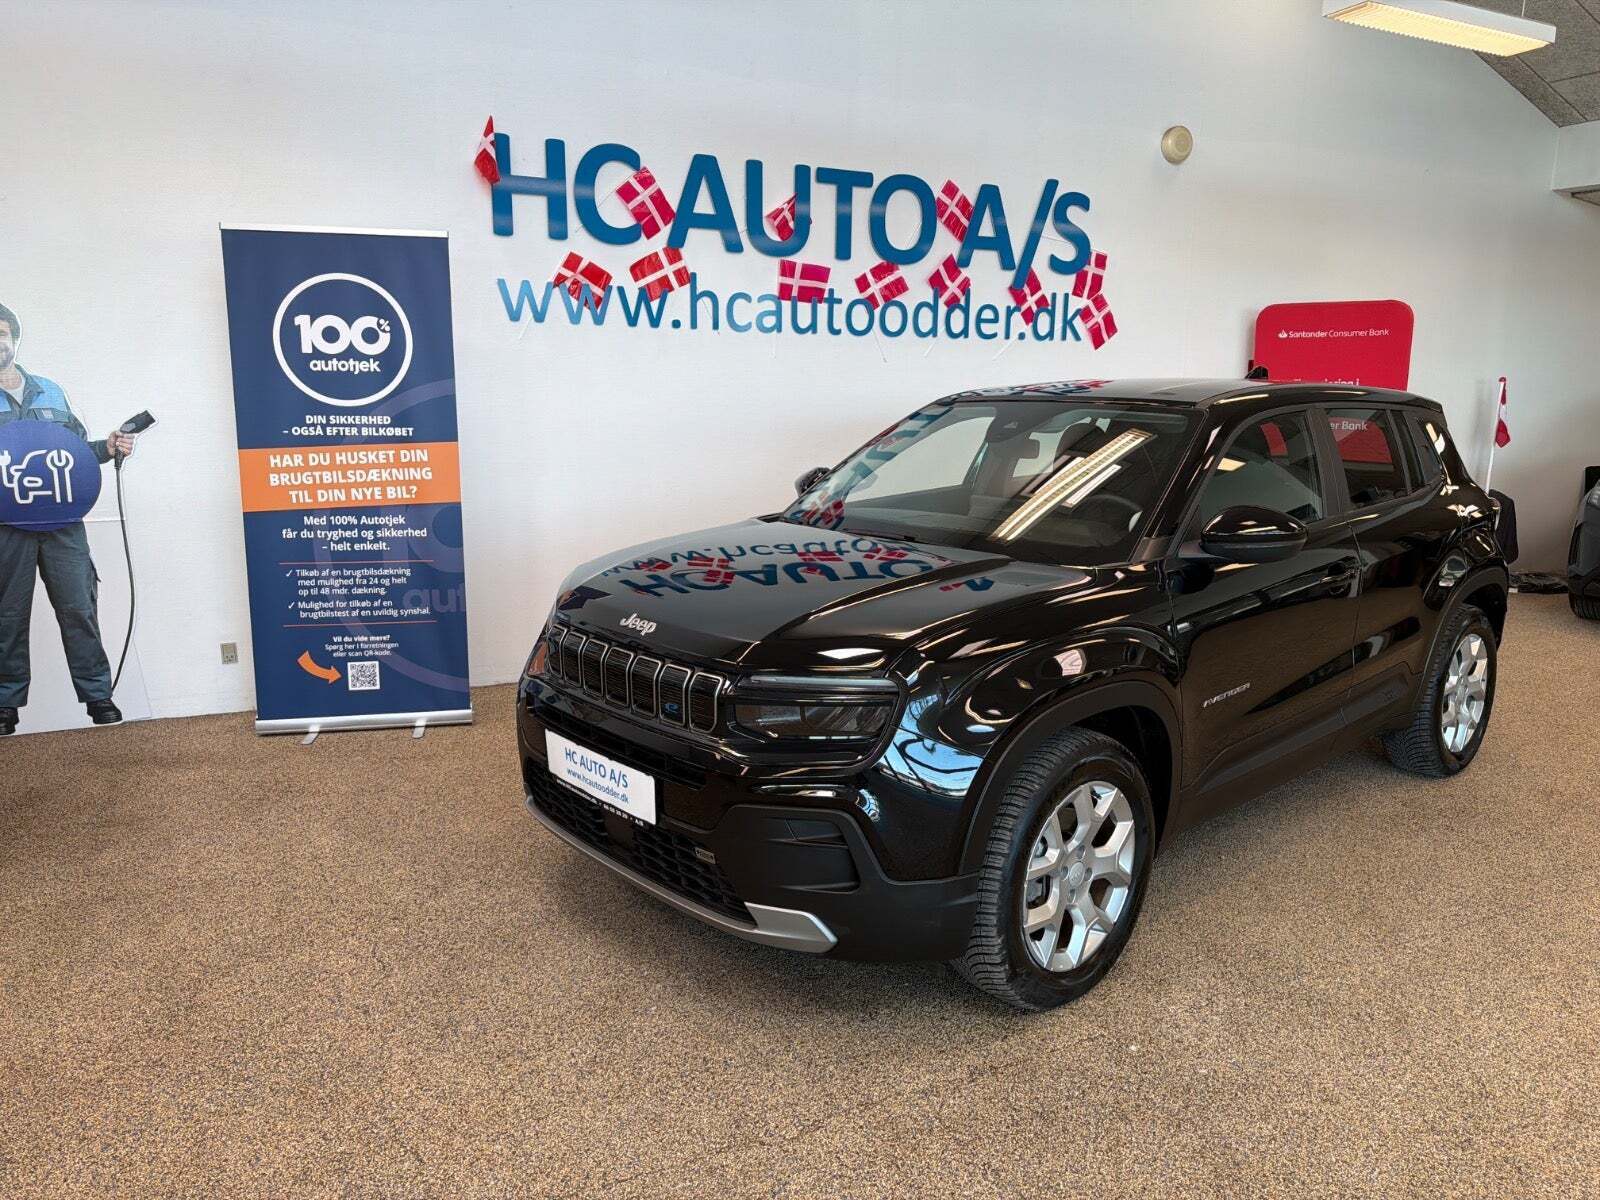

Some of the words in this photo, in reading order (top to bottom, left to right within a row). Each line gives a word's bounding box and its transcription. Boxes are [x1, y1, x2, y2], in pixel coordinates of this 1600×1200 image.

[491, 132, 642, 246] HC
[667, 153, 937, 265] AUTO
[957, 179, 1091, 290] A/S
[497, 272, 1082, 341] www.hcautoodder.dk
[1289, 330, 1328, 338] Santander
[1329, 329, 1369, 337] Consumer
[1370, 328, 1390, 336] Bank
[310, 358, 381, 374] autotjek
[306, 415, 326, 425] DIN
[329, 415, 391, 425] SIKKERHED
[292, 424, 323, 436] OGSÅ
[327, 427, 358, 436] EFTER
[362, 426, 414, 437] BILKØBET
[270, 454, 304, 468] HAR
[309, 453, 330, 466] DU
[336, 450, 395, 465] HUSKET
[400, 449, 428, 463] DIN
[270, 468, 432, 486] BRUGTBILSDÆKNING
[289, 490, 313, 504] TIL
[317, 489, 346, 503] DIN
[351, 488, 382, 501] NYE
[387, 486, 417, 499] BIL?
[304, 516, 326, 526] Med
[330, 516, 357, 525] 100%
[360, 516, 405, 528] Autotjek
[282, 529, 298, 539] får
[301, 529, 314, 538] du
[317, 529, 358, 541] tryghed
[361, 530, 374, 540] og
[376, 528, 427, 537] sikkerhed
[330, 541, 350, 551] helt
[354, 542, 390, 551] enkelt.
[296, 569, 320, 577] Tilkøb
[343, 568, 411, 577] brugtbilsdækning
[318, 578, 354, 587] mulighed
[380, 578, 390, 586] og
[351, 586, 387, 596] dækning.
[298, 601, 334, 610] Mulighed
[336, 600, 347, 608] for
[373, 599, 381, 607] af
[300, 610, 350, 619] brugtbilstest
[351, 609, 360, 617] af
[373, 608, 398, 617] uvildig
[620, 613, 657, 636] Jeep
[565, 747, 578, 765] HC
[580, 755, 607, 778] AUTO
[610, 768, 628, 788] A/S
